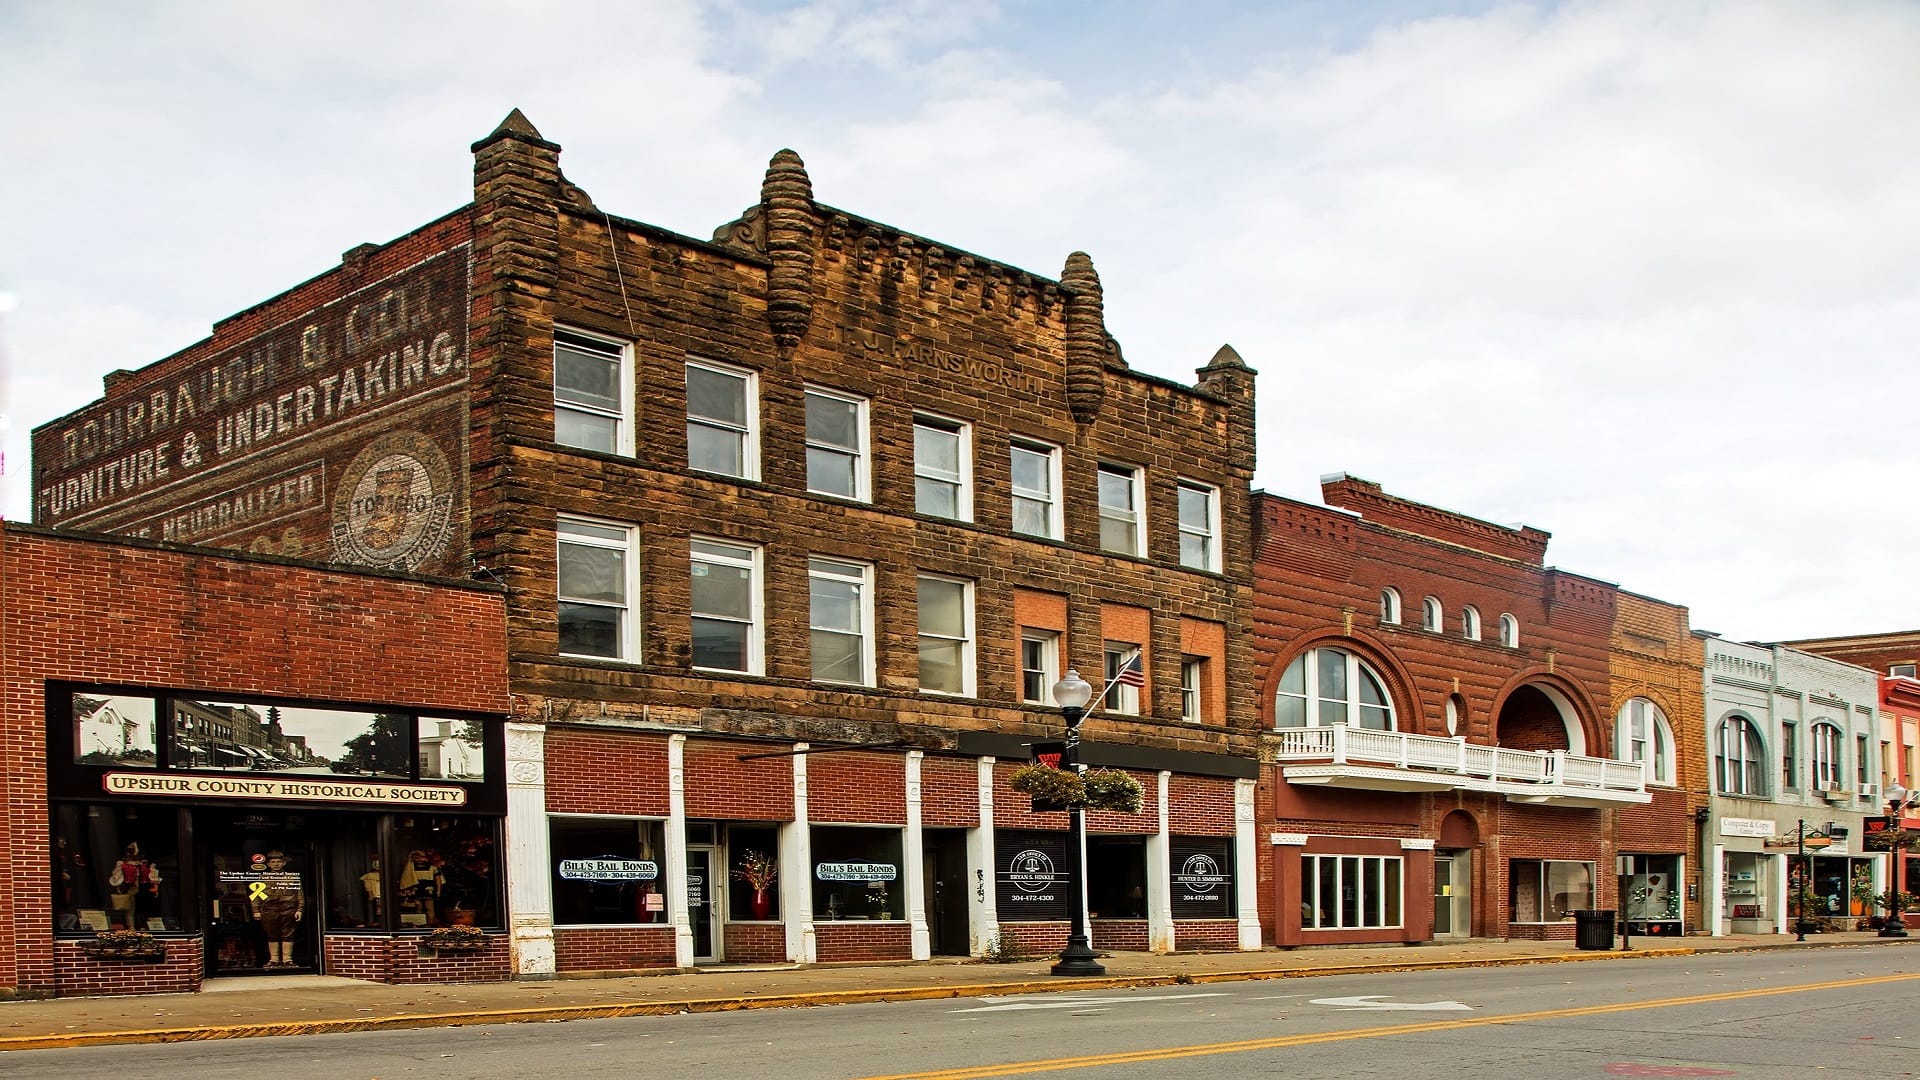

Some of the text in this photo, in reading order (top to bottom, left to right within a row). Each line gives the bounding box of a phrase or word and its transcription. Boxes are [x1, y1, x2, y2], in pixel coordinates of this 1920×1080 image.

[38, 441, 170, 516] FURNITURE
[181, 431, 202, 468] &
[216, 330, 464, 456] UNDERTAKING.
[112, 777, 461, 801] UPSHUR COUNTY HISTORICAL SOCIETY
[564, 861, 654, 871] BILL'S BAIL BONDS
[820, 863, 894, 873] BILL'S BAIL BONDS
